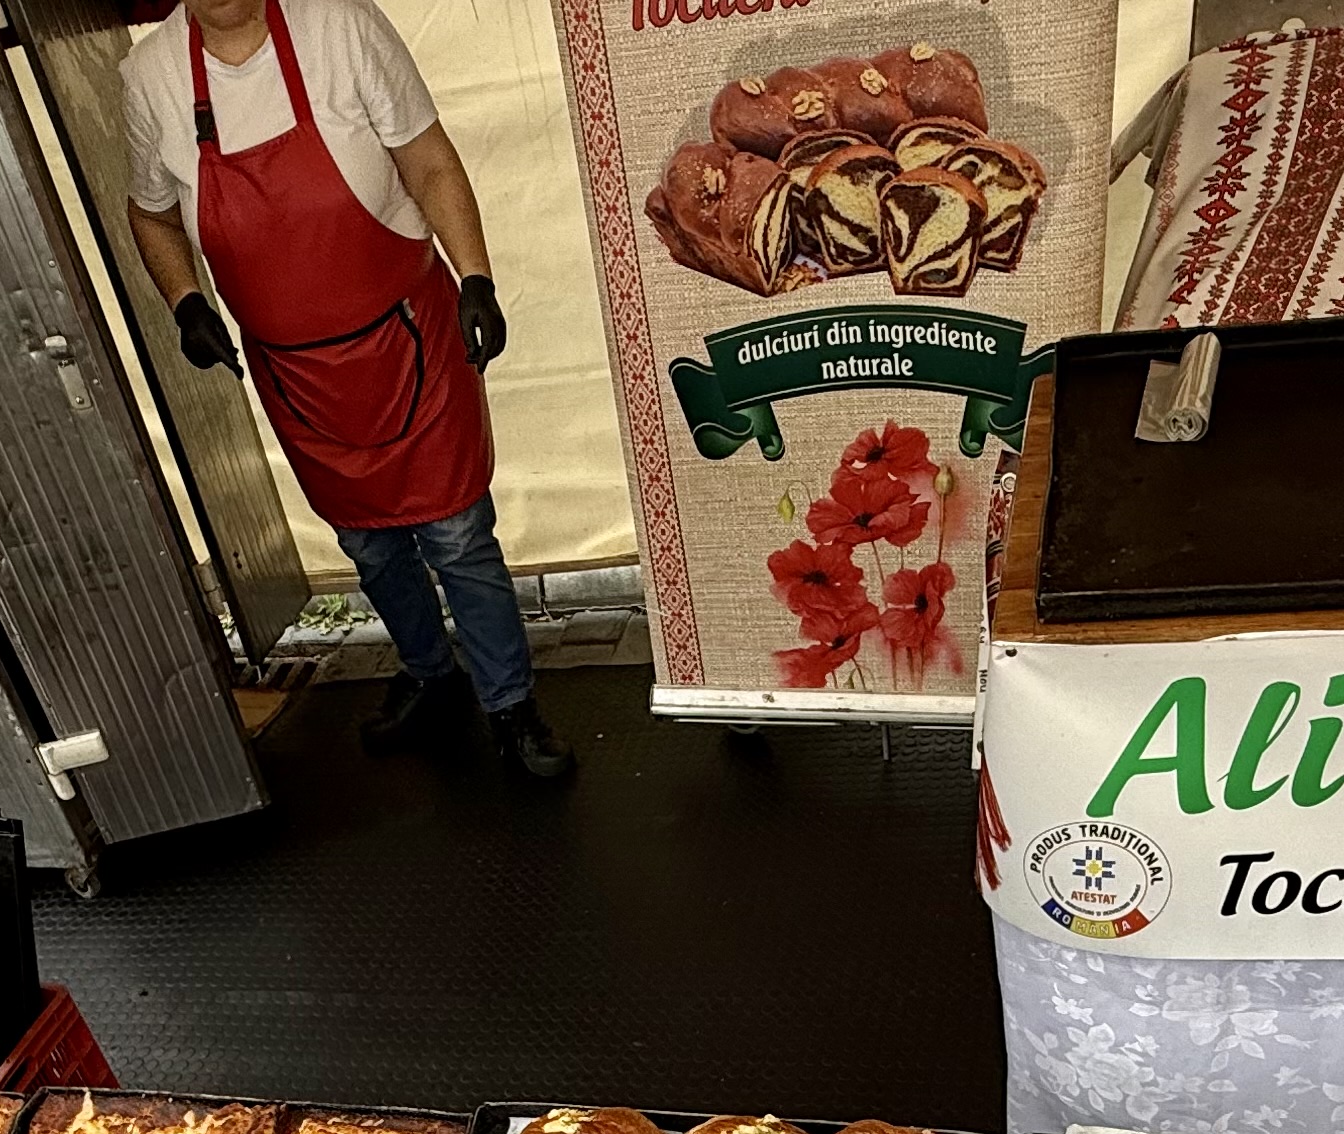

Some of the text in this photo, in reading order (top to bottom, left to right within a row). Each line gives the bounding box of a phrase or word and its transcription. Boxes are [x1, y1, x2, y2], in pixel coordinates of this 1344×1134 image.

[738, 320, 997, 365] dulciuri din ingrediente
[821, 353, 914, 380] naturale
[1030, 828, 1071, 873] PRODUS
[1071, 890, 1117, 905] ATESTAT
